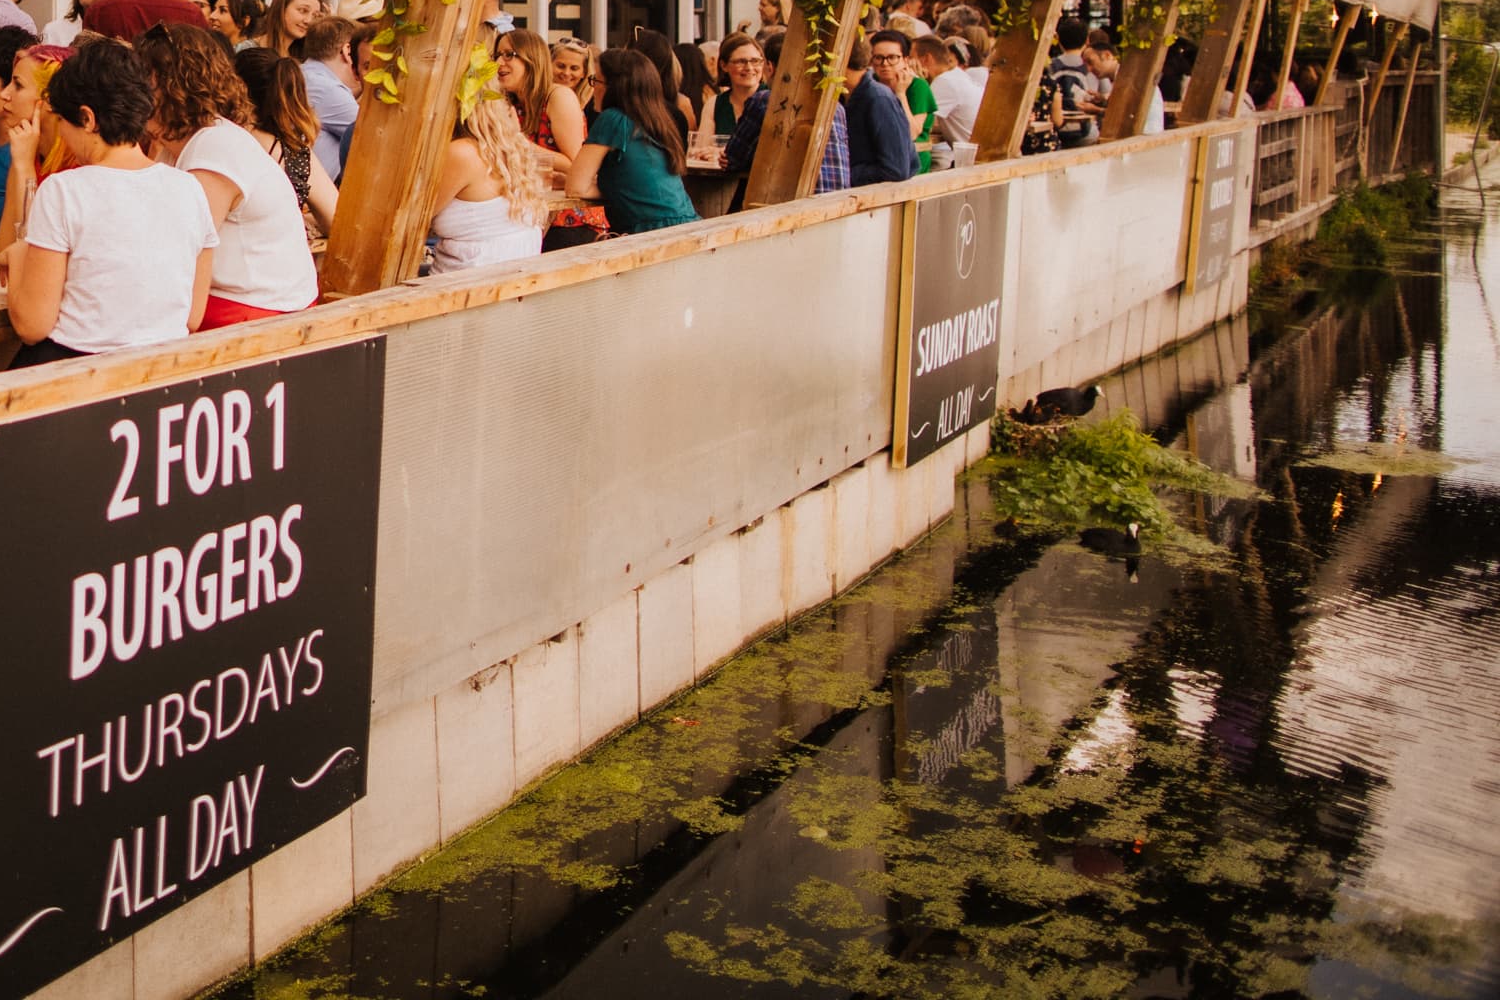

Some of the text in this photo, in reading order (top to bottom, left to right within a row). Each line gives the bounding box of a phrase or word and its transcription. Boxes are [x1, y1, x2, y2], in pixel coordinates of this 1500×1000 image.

[916, 298, 1000, 377] SUNDAY ROAST
[936, 384, 975, 442] ALL DAY
[107, 381, 285, 522] 2 FOR 1
[69, 504, 303, 681] BURGERS
[37, 629, 325, 818] THURSDAYS
[100, 765, 267, 932] ALL DAY
